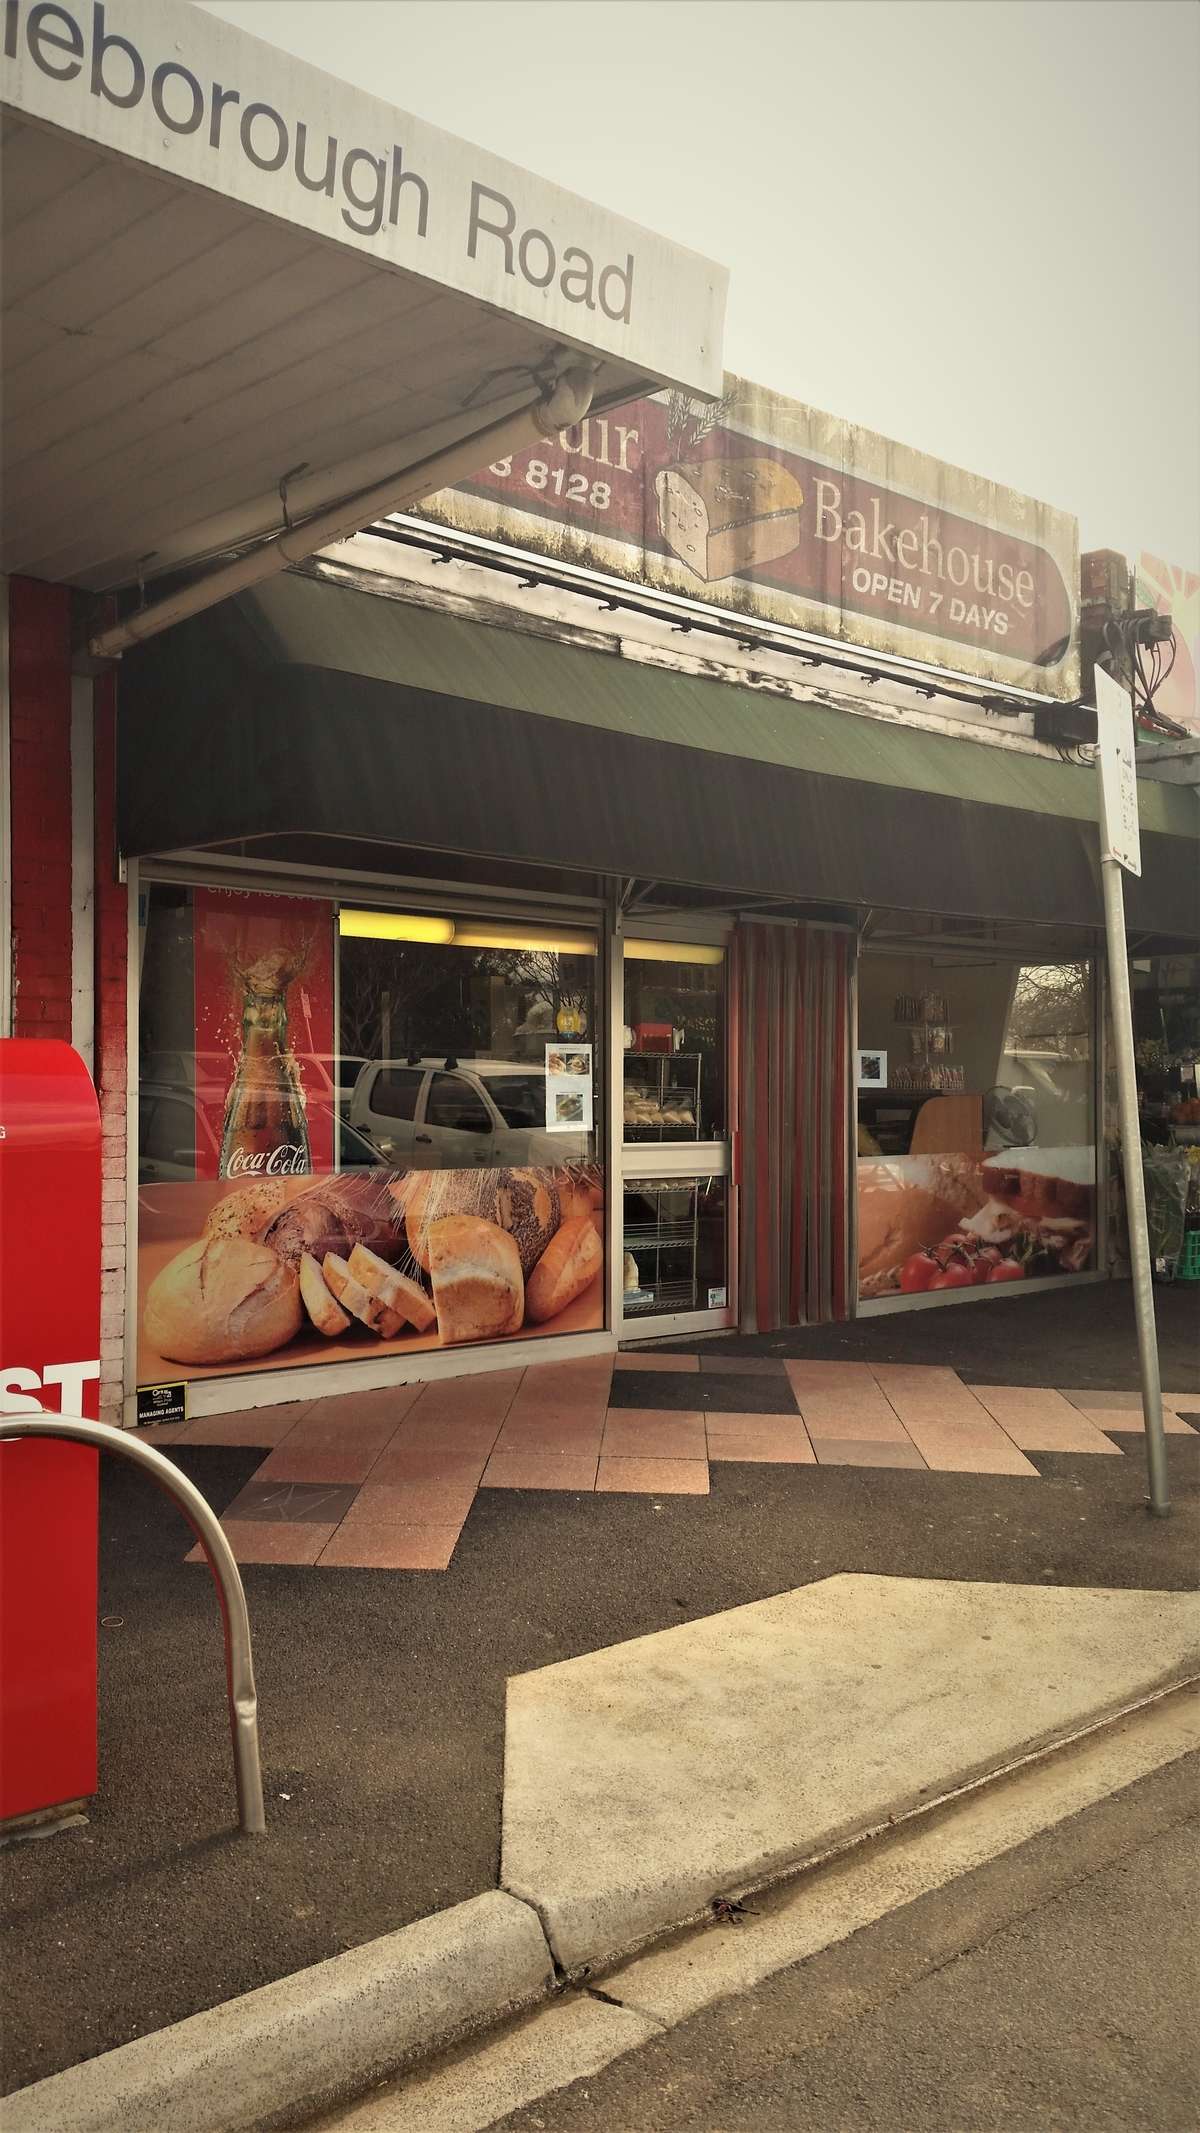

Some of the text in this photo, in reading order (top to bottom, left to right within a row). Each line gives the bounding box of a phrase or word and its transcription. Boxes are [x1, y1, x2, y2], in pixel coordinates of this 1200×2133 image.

[467, 180, 634, 325] Road
[525, 459, 612, 510] 8128
[812, 476, 1035, 608] Bakehouse
[852, 567, 1009, 635] OPEN 7 DAYS
